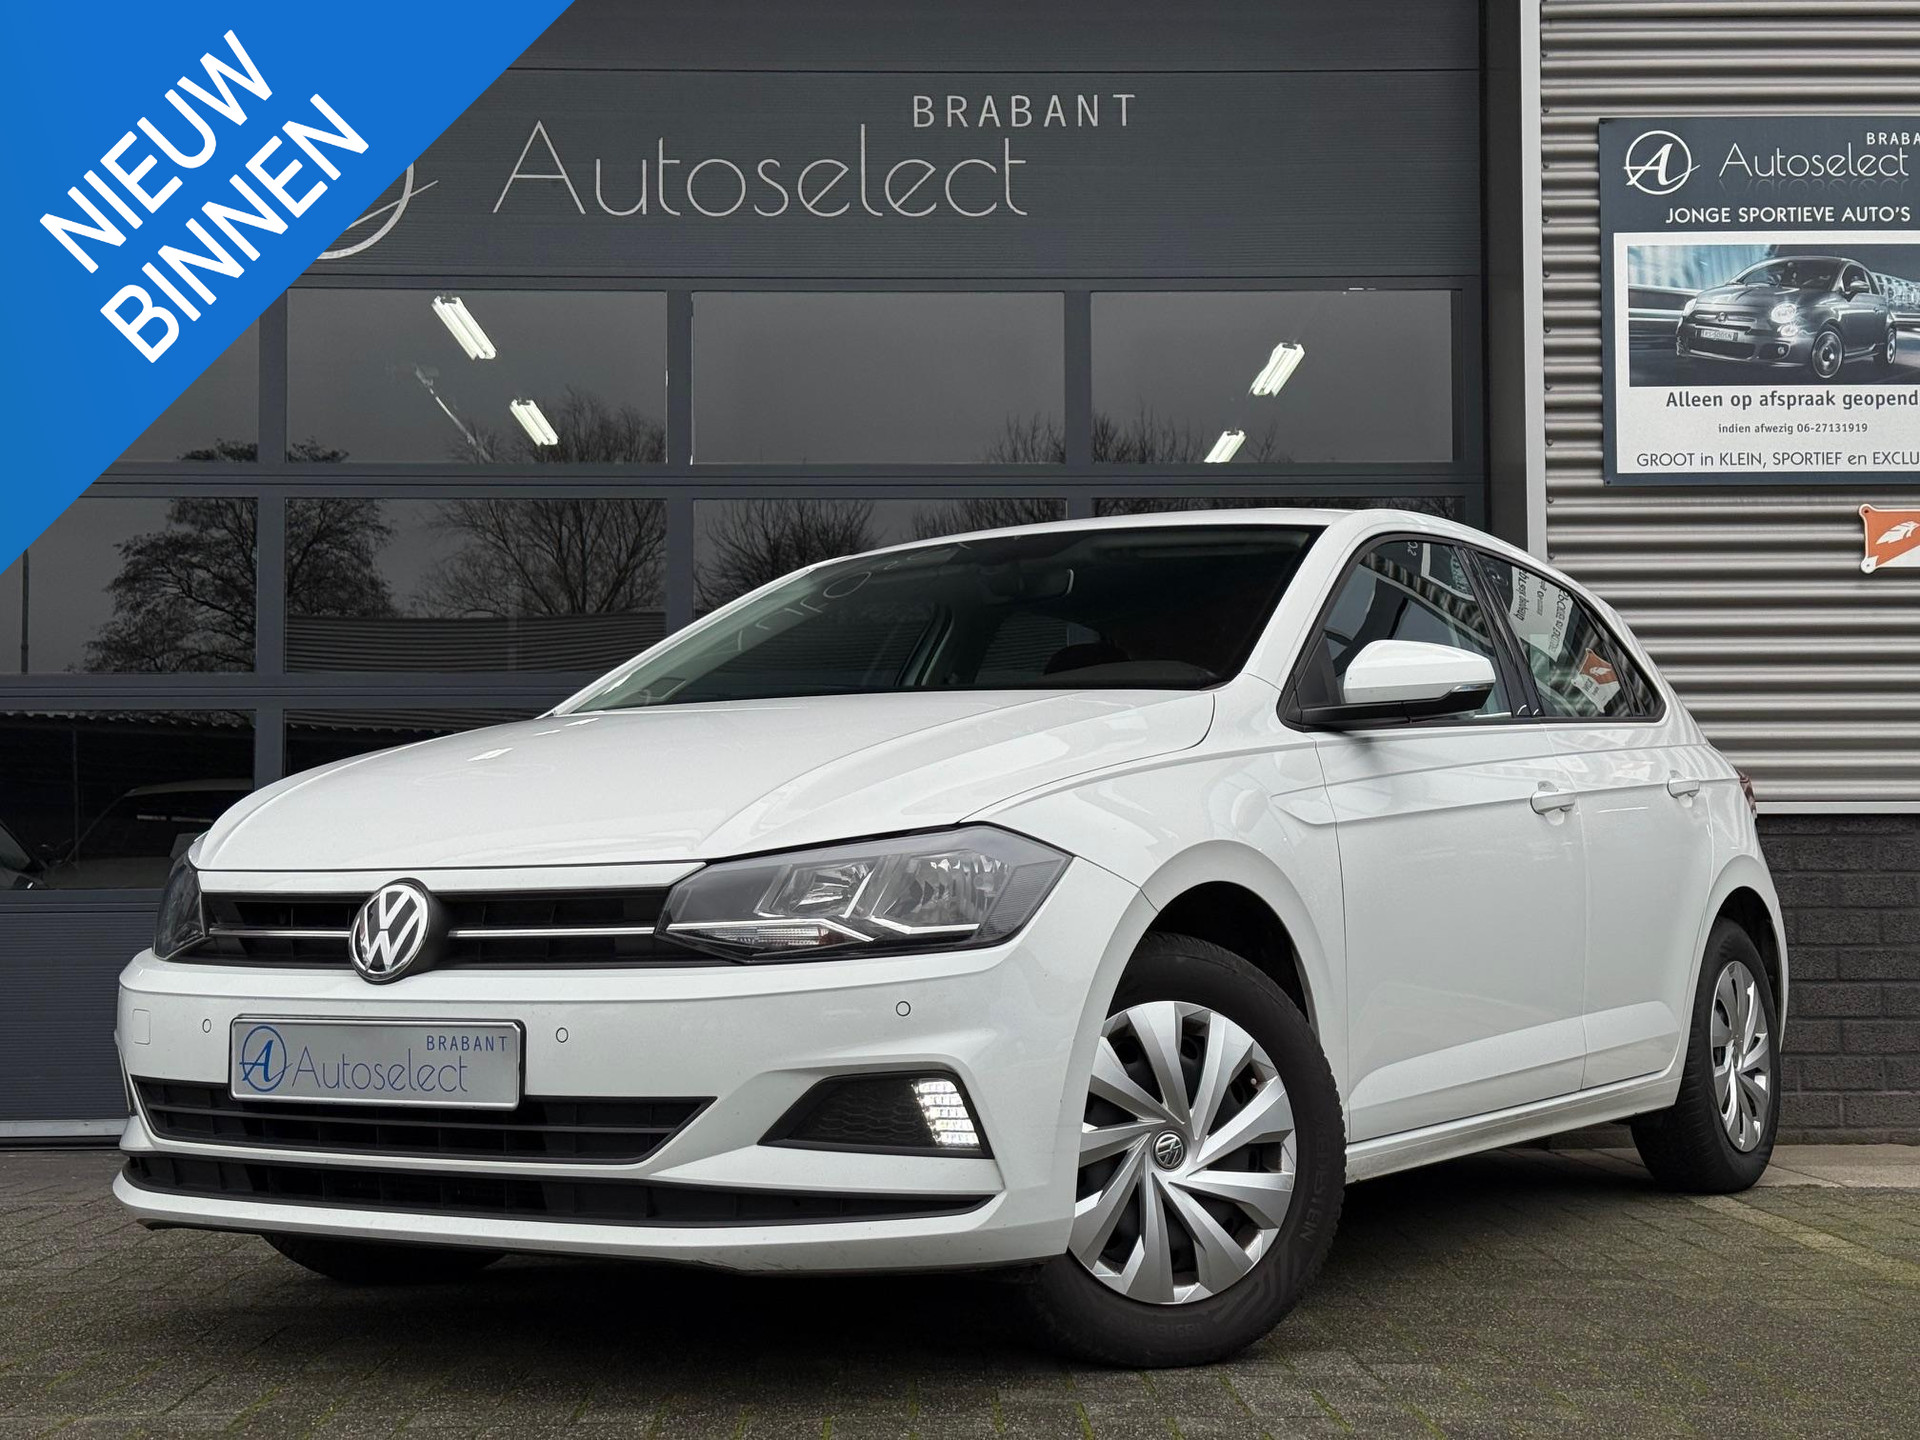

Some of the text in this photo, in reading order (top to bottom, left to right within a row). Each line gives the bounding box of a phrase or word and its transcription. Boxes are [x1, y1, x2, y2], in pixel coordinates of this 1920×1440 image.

[913, 94, 1136, 128] BRABANT
[493, 120, 1029, 217] Autoselect
[1719, 142, 1910, 177] Autoselect
[1665, 206, 1911, 224] JONGE SPORTIEVE AUTO'S
[1665, 390, 1919, 411] Alleen op afspraak geopend
[1718, 422, 1868, 435] indien afwezig 06-27131919
[1636, 452, 1696, 467] GROOT
[1700, 452, 1714, 466] in
[1719, 452, 1767, 469] KLEIN,
[1772, 451, 1843, 466] SPORTIEF
[1847, 454, 1867, 466] en
[426, 1035, 508, 1052] BRABANT
[291, 1046, 468, 1092] Autoselect
